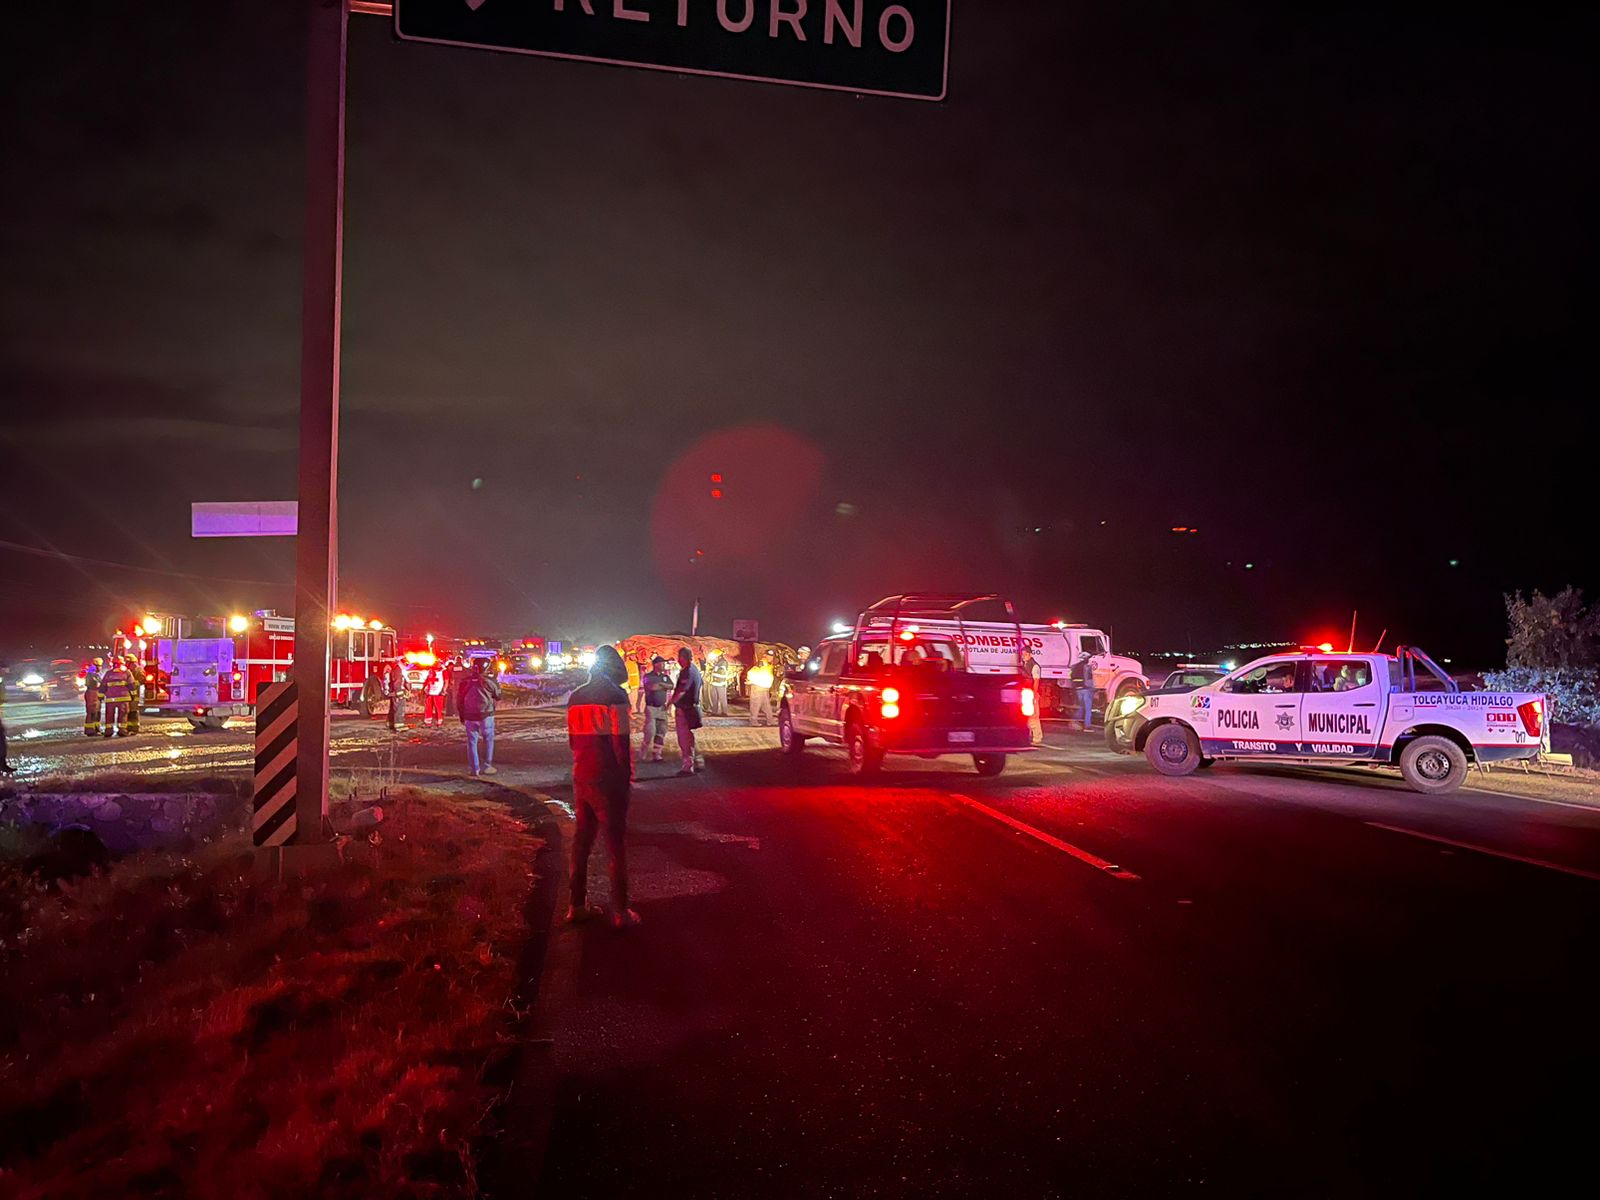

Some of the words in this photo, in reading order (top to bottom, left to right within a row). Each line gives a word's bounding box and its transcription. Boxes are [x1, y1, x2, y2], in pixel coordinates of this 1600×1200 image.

[953, 634, 1043, 647] BOMBEROS
[1412, 695, 1469, 705] TOLCAYUCA
[1471, 695, 1514, 706] HIDALGO
[1218, 709, 1259, 729] POLICIA
[1308, 713, 1371, 734] MUNICIPAL
[1487, 713, 1517, 722] 911
[1232, 740, 1278, 751] TRANSITO
[1294, 742, 1303, 752] Y
[1311, 743, 1355, 754] VIALIDAD
